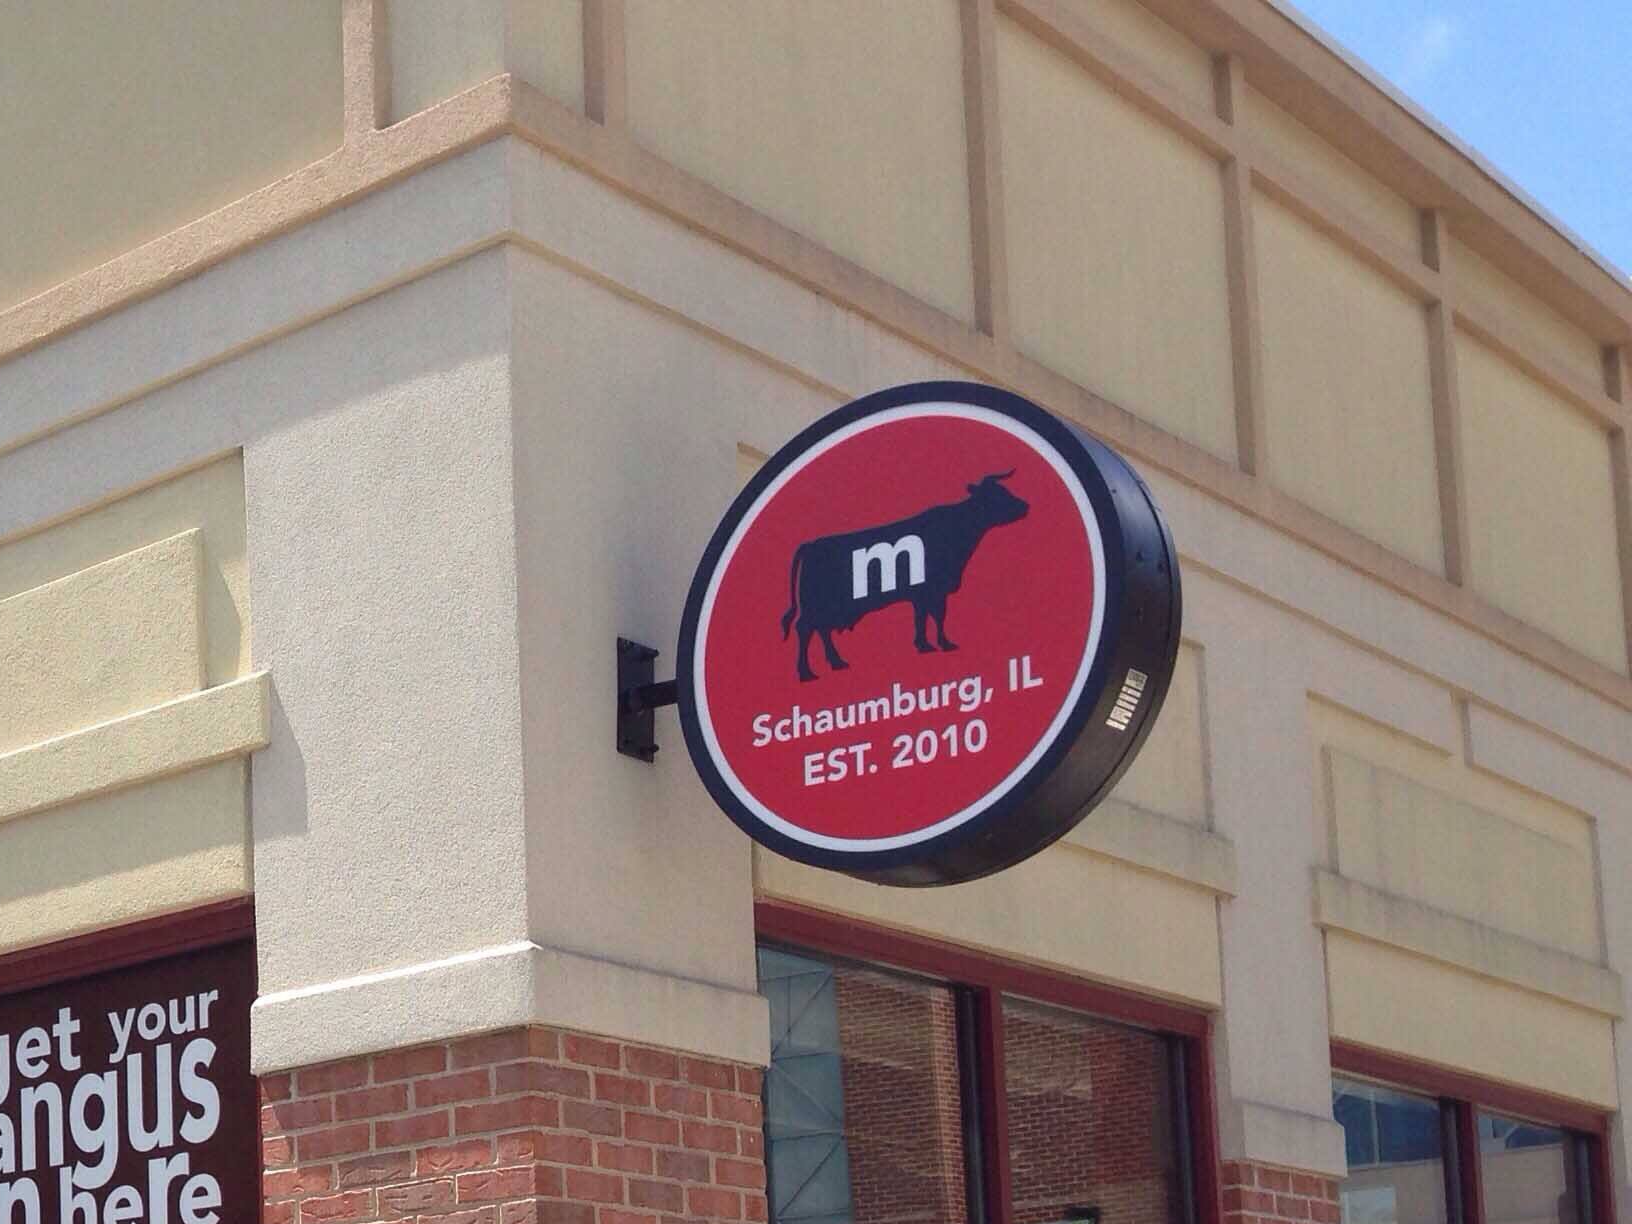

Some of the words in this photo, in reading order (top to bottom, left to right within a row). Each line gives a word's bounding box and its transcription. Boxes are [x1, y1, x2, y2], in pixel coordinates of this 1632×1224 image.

[851, 533, 926, 600] m
[752, 675, 994, 747] Schaumburg,
[1008, 655, 1044, 692] IL
[803, 742, 878, 786] EST.
[891, 718, 988, 769] 2010
[107, 989, 219, 1064] your
